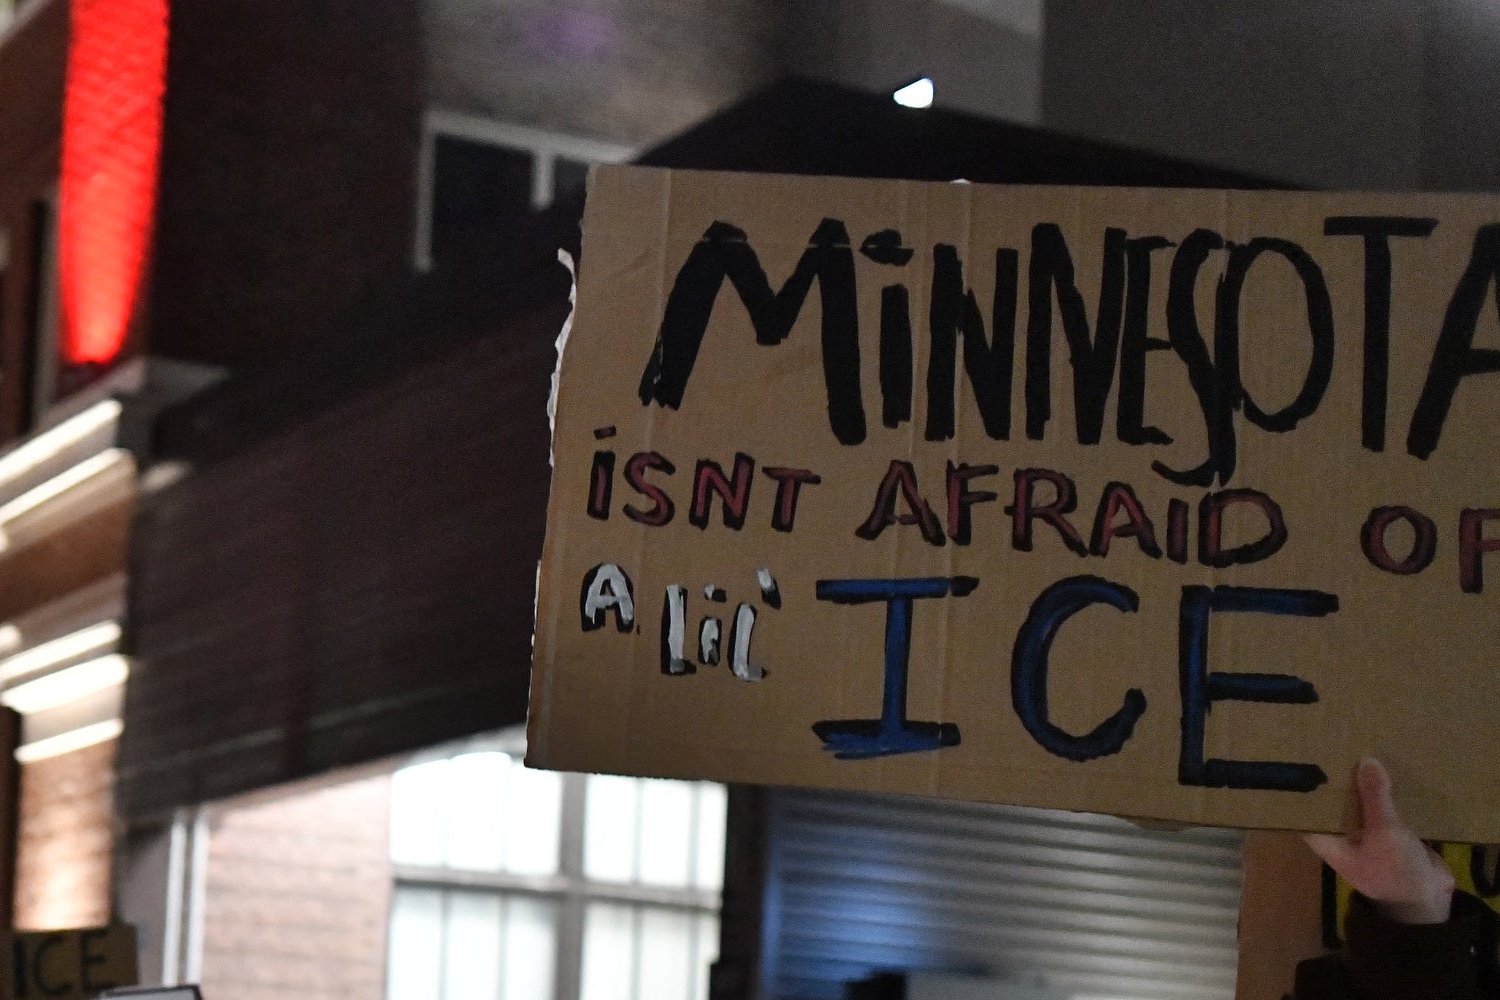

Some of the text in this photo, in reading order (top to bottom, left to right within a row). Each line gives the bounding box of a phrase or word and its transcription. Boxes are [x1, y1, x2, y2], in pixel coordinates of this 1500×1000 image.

[856, 459, 1289, 568] AFRAID
[580, 562, 636, 634] A
[812, 574, 1340, 794] ICE
[12, 929, 117, 997] ICE
